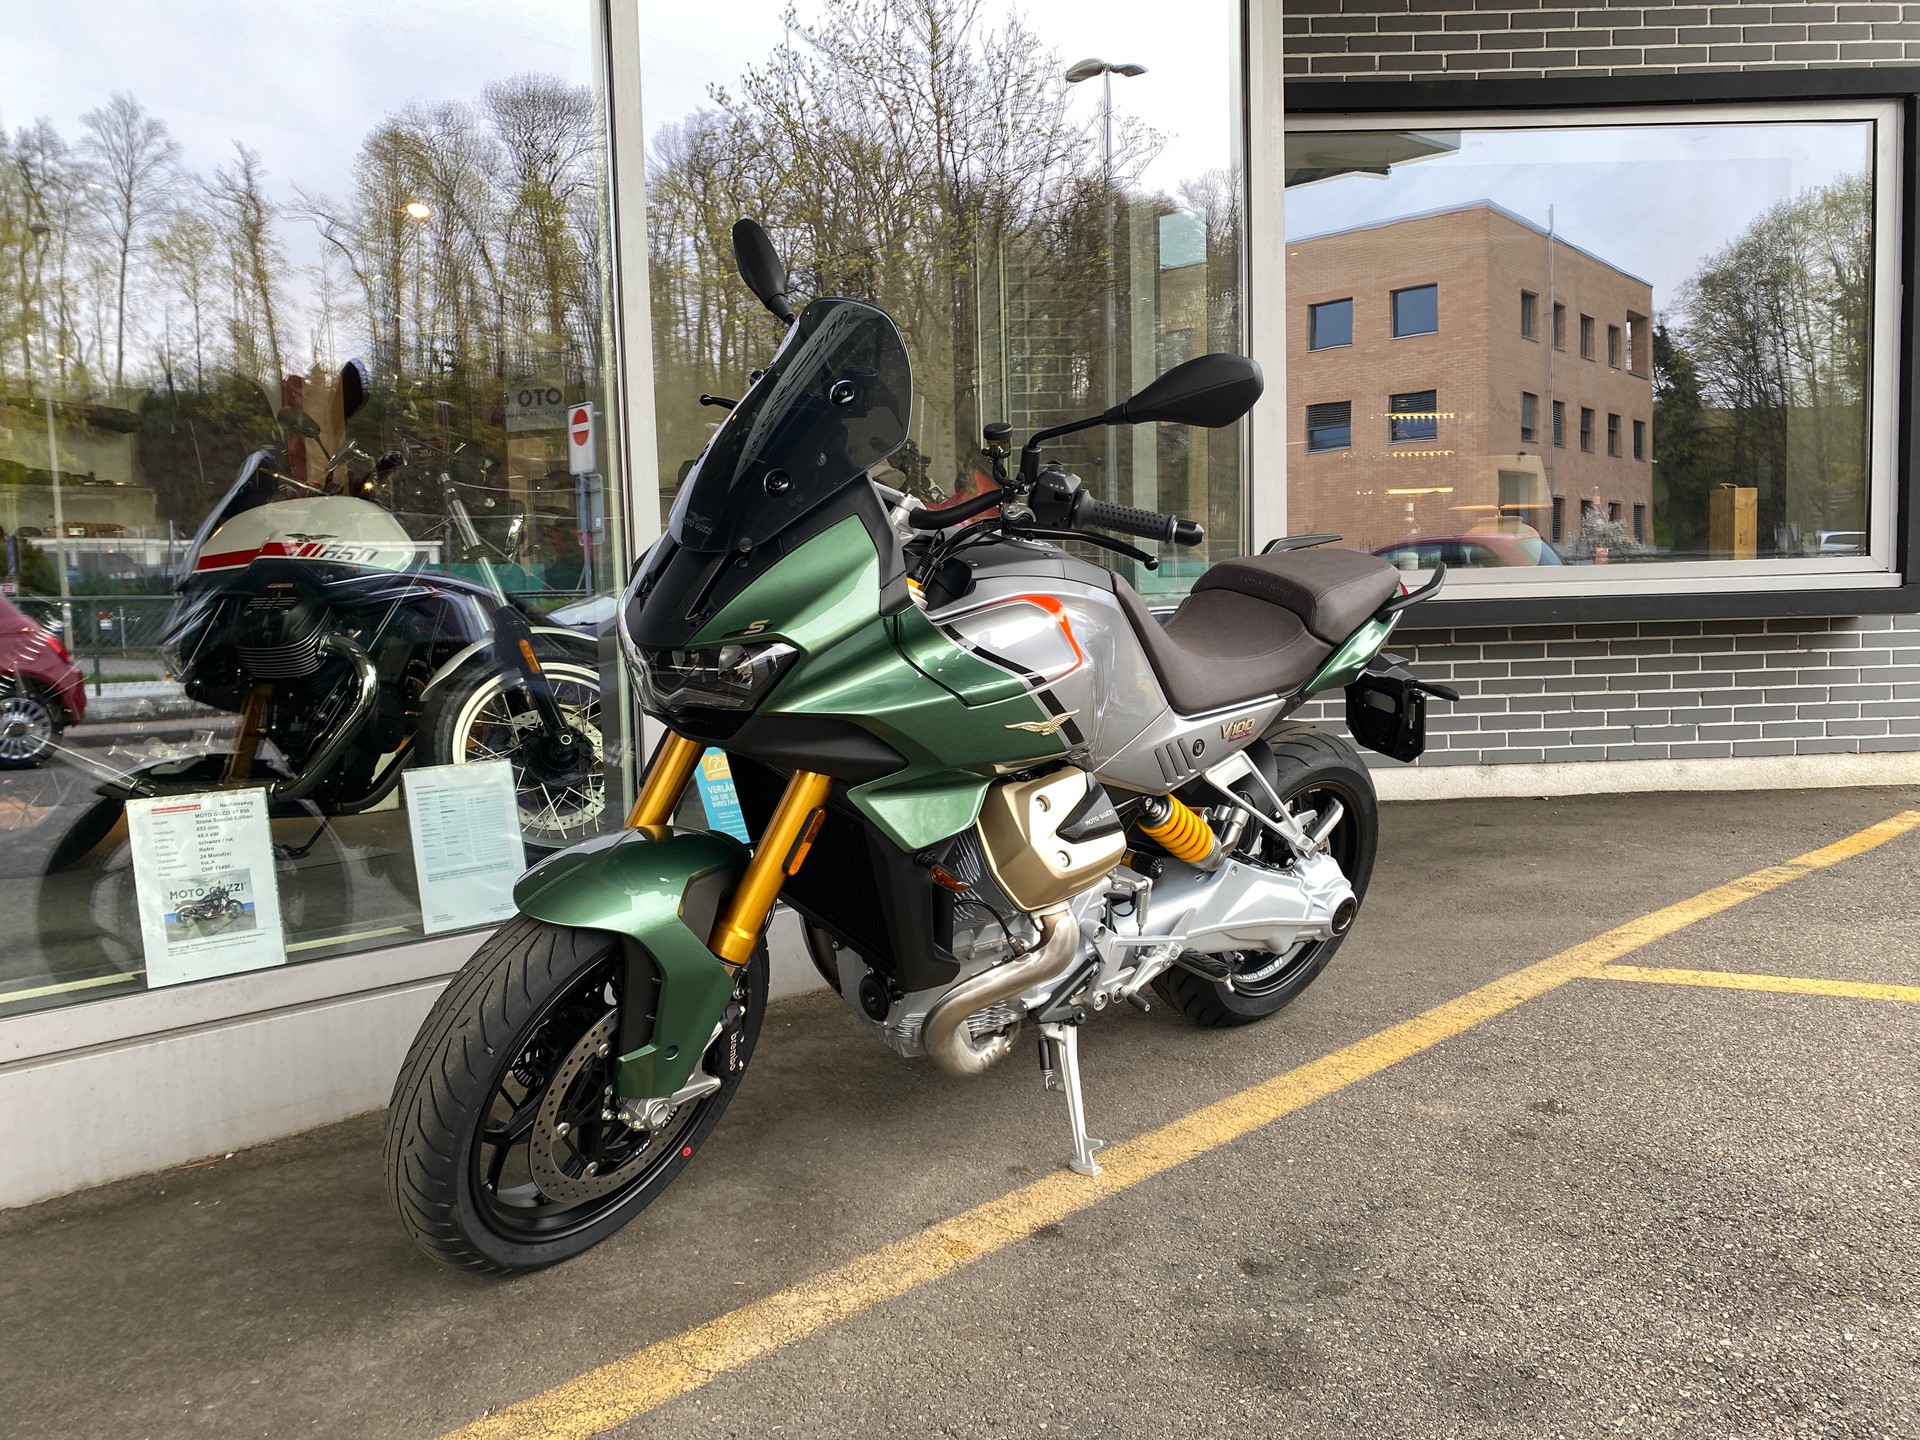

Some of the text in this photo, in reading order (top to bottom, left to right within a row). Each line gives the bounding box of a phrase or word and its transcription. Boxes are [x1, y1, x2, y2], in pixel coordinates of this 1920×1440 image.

[319, 544, 379, 562] 850
[1221, 718, 1256, 739] V100
[220, 800, 254, 808] Neufahrzeug
[213, 816, 233, 824] Special
[1084, 808, 1115, 827] MOTO GUZZI
[207, 851, 232, 859] Monat(e)
[169, 887, 205, 900] MOTO
[1242, 964, 1275, 981] MOTO GUZZI
[729, 1030, 740, 1071] brembo
